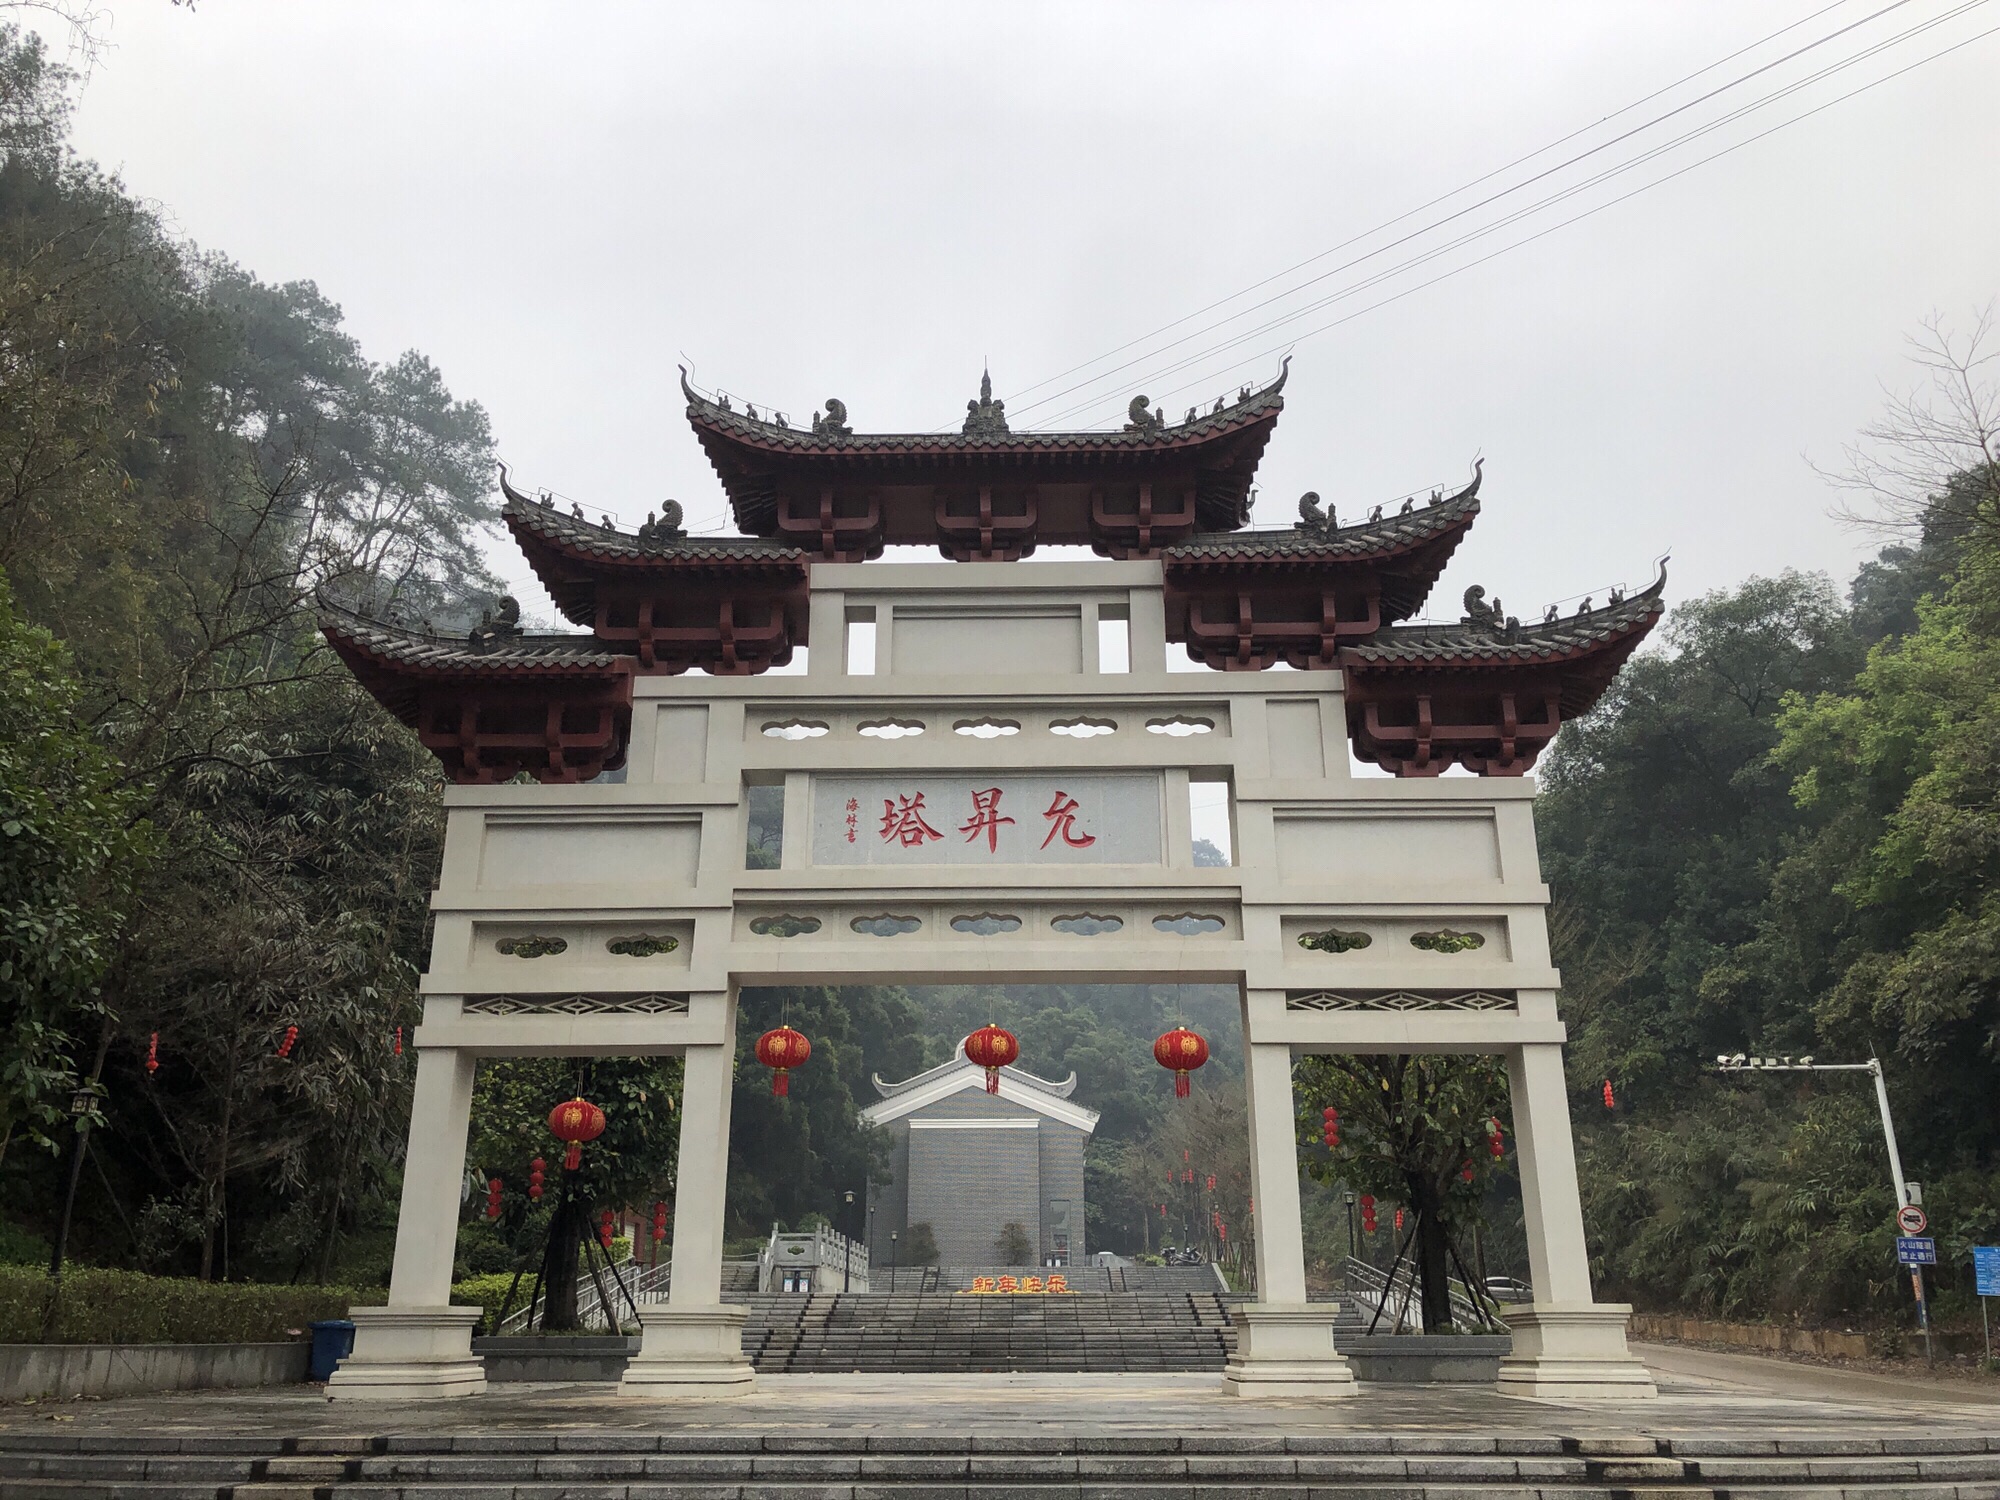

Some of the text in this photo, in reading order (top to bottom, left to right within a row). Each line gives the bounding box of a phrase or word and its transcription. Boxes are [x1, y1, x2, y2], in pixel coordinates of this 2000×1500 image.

[1901, 1251, 1933, 1260] 禁止通行
[973, 1274, 1067, 1292] 新年快乐
